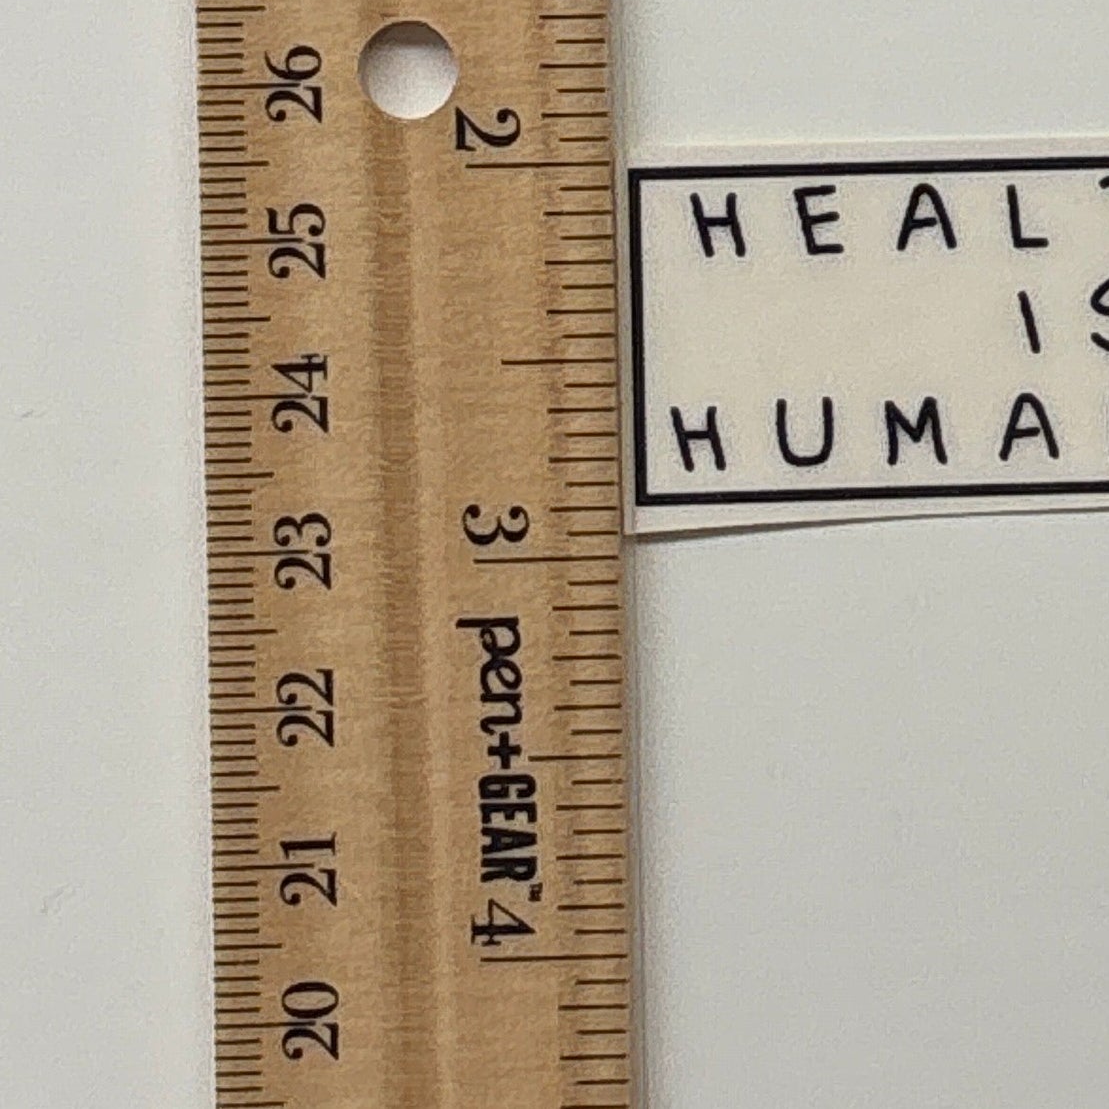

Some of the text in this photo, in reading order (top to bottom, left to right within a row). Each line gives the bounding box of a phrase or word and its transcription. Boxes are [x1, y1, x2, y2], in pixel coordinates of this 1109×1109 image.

[263, 45, 323, 124] 26
[454, 106, 522, 152] 2
[265, 202, 326, 280] 25
[270, 352, 330, 434] 24
[272, 512, 333, 591] 23
[461, 503, 531, 547] 3
[275, 668, 335, 748] 22
[278, 831, 338, 908] 21
[470, 897, 537, 948] 4
[280, 980, 340, 1061] 20
